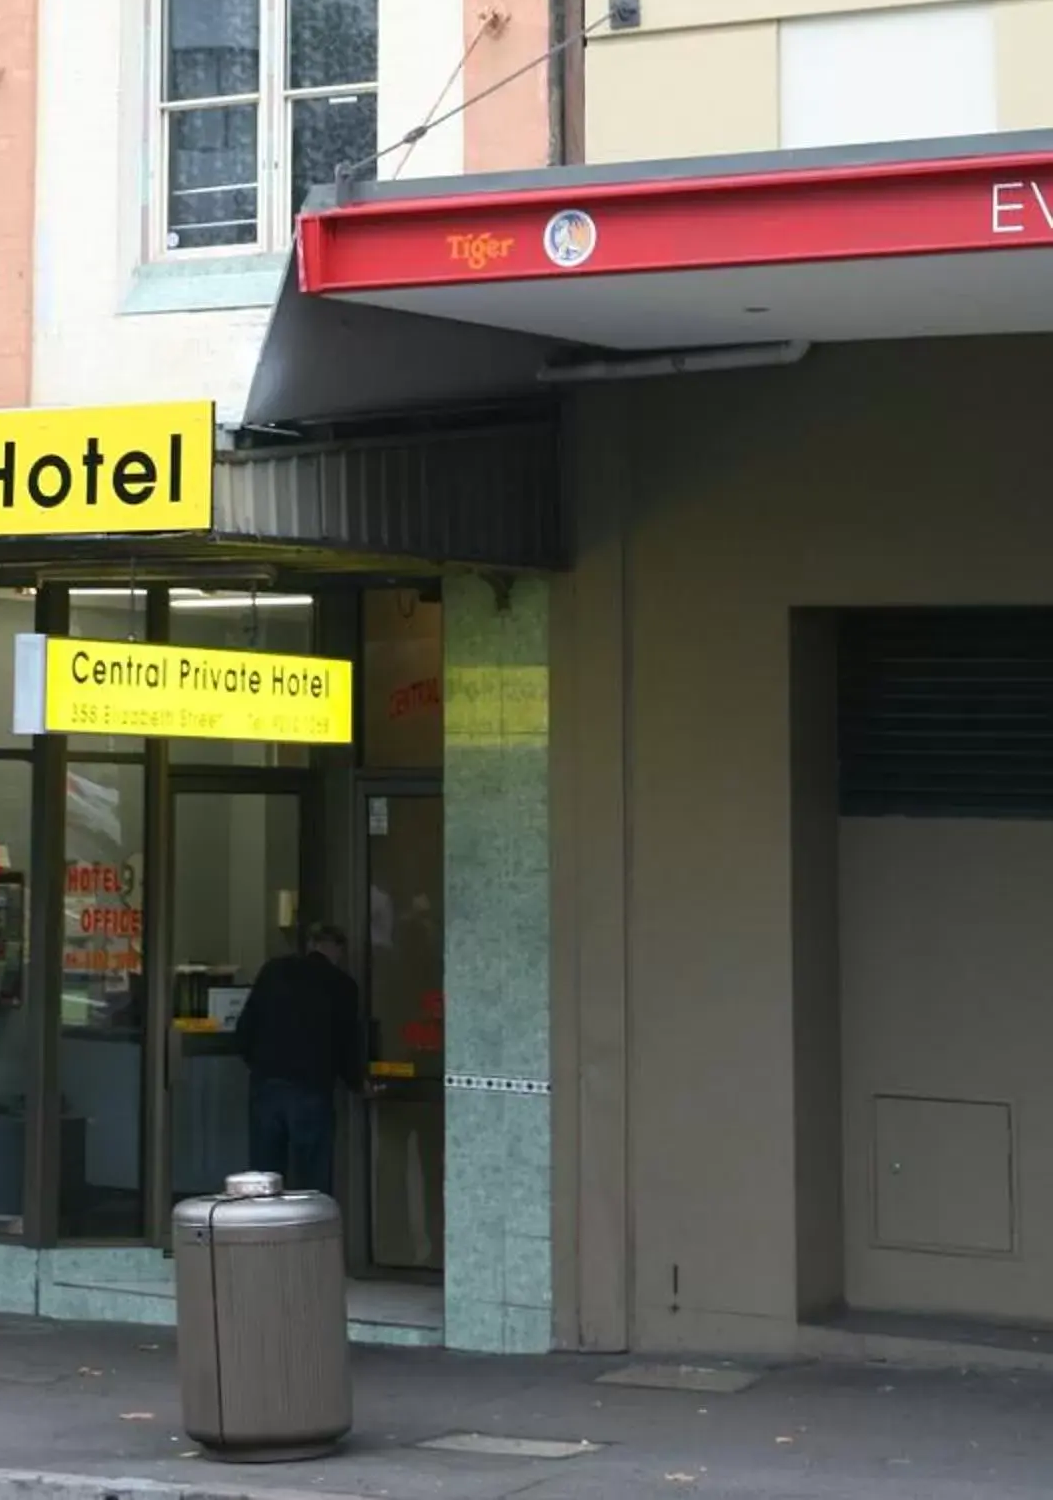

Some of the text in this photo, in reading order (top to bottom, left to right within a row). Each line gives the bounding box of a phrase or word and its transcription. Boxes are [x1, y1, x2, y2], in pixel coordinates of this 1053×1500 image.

[447, 232, 514, 269] Tiger
[72, 651, 330, 699] Central Private Hotel
[65, 863, 122, 893] HOTEL
[80, 908, 141, 935] OFFICE
